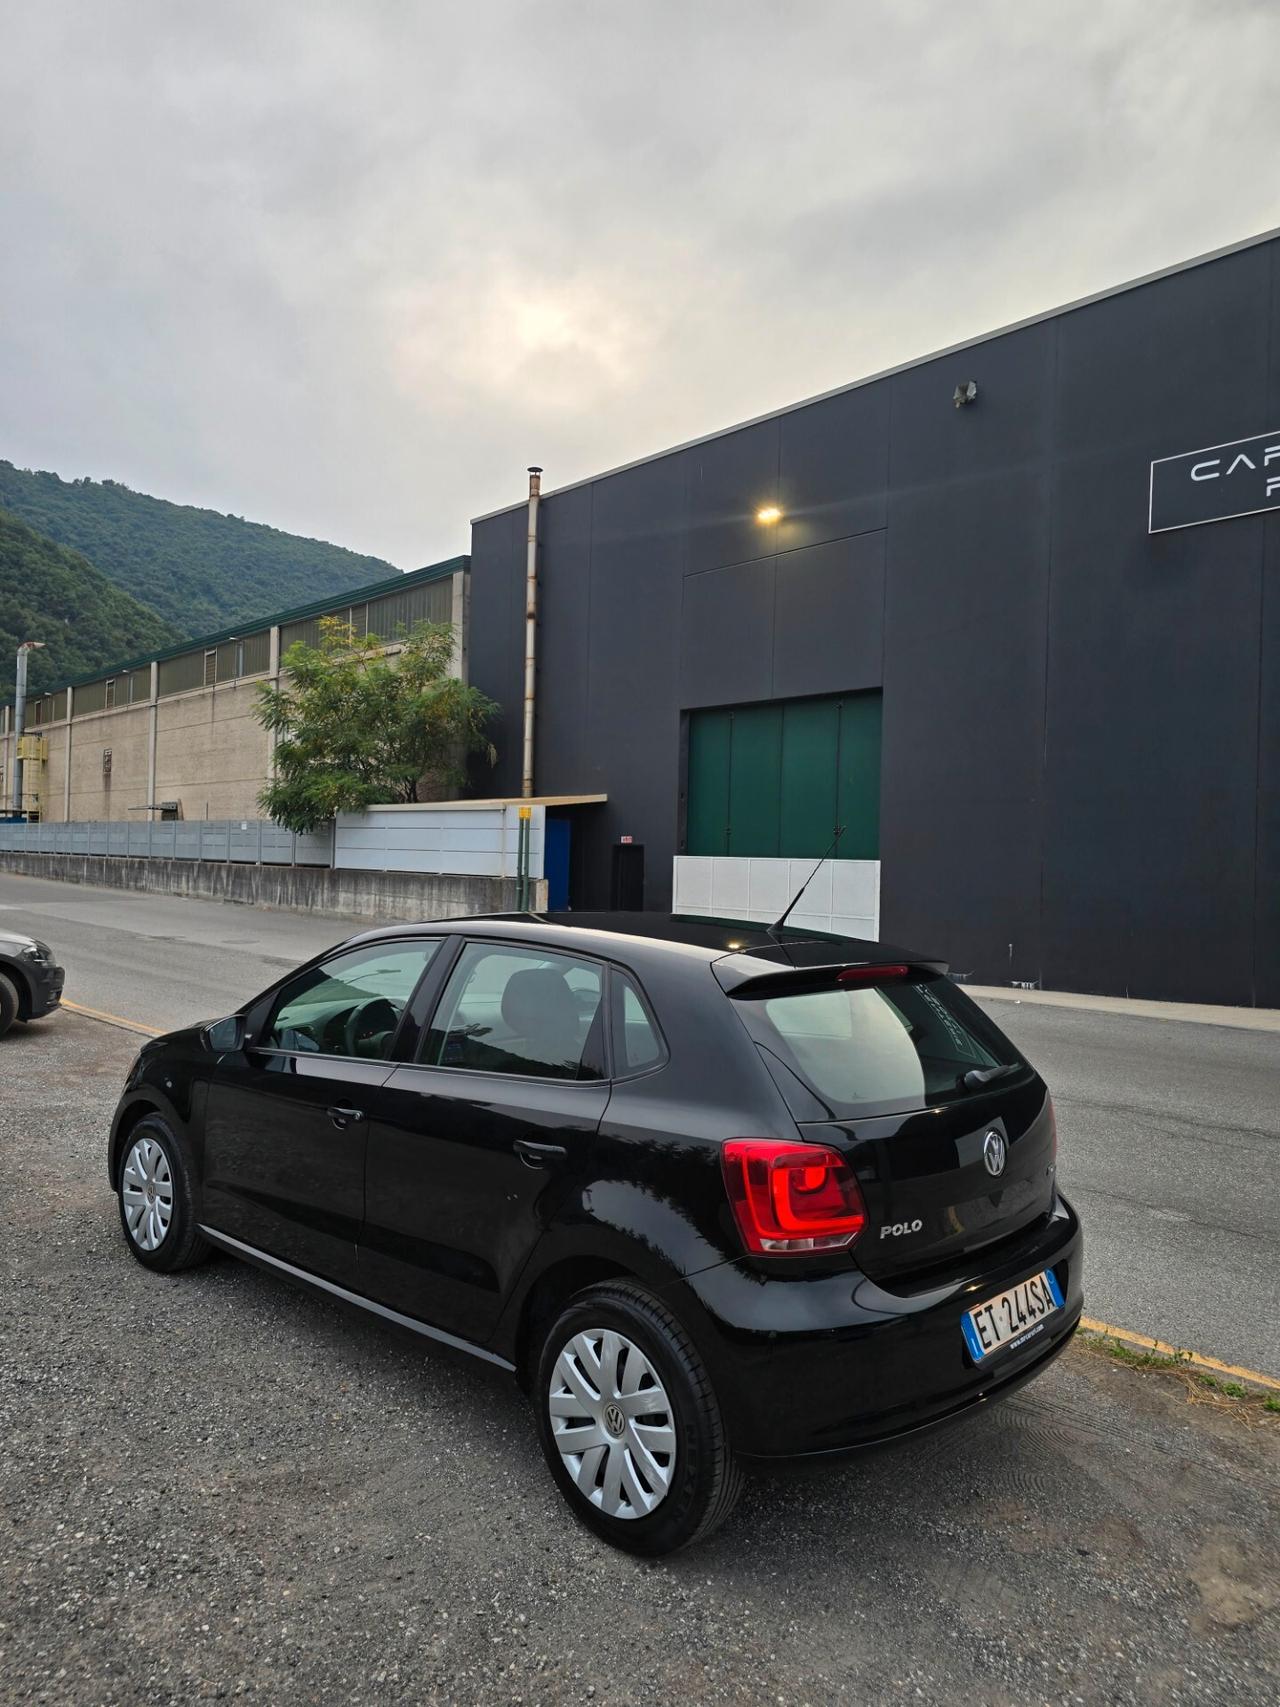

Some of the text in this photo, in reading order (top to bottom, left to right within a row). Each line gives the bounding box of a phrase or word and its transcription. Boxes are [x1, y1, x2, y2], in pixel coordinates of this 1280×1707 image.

[880, 1219, 923, 1239] POLO
[973, 1275, 1055, 1350] ET 244SA
